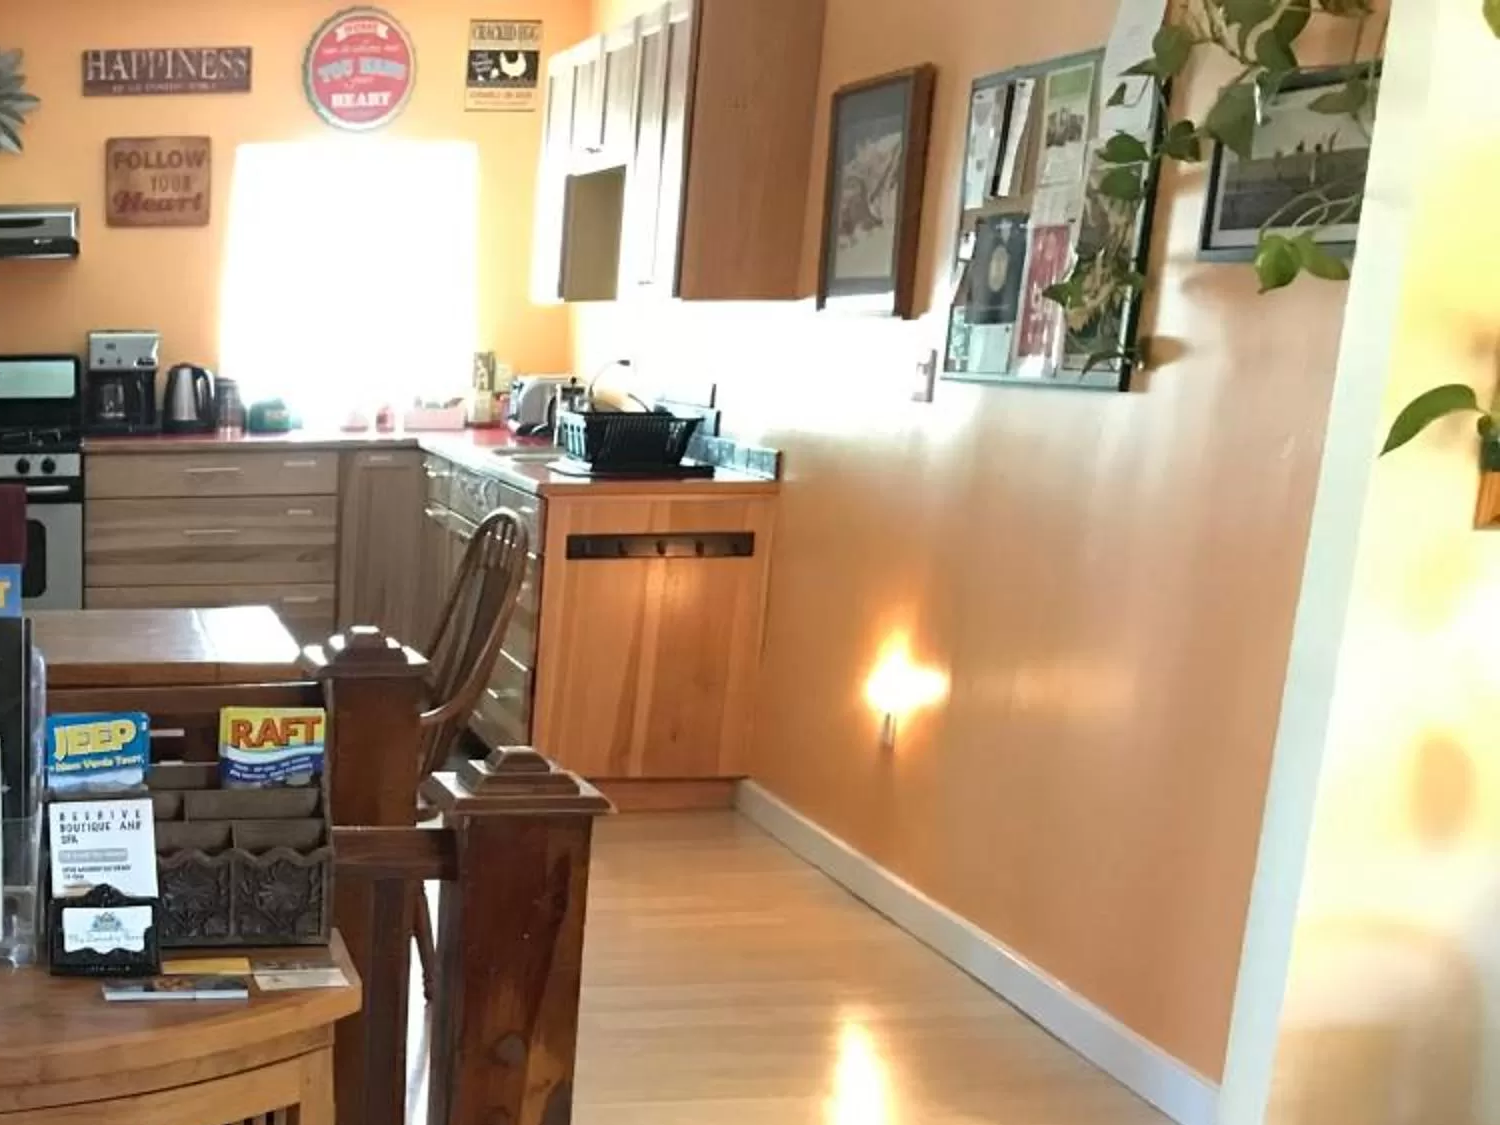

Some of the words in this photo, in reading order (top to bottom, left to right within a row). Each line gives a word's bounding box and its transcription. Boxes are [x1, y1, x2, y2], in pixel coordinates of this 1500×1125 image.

[86, 49, 247, 80] HAPPINESS
[331, 92, 390, 107] HEART
[114, 150, 205, 169] FOLLOW
[112, 190, 202, 214] Heart
[53, 718, 137, 761] JEEP
[230, 715, 322, 748] RAFT
[59, 822, 111, 834] BOUTIQUE
[119, 821, 143, 832] AND
[61, 835, 79, 845] SPA
